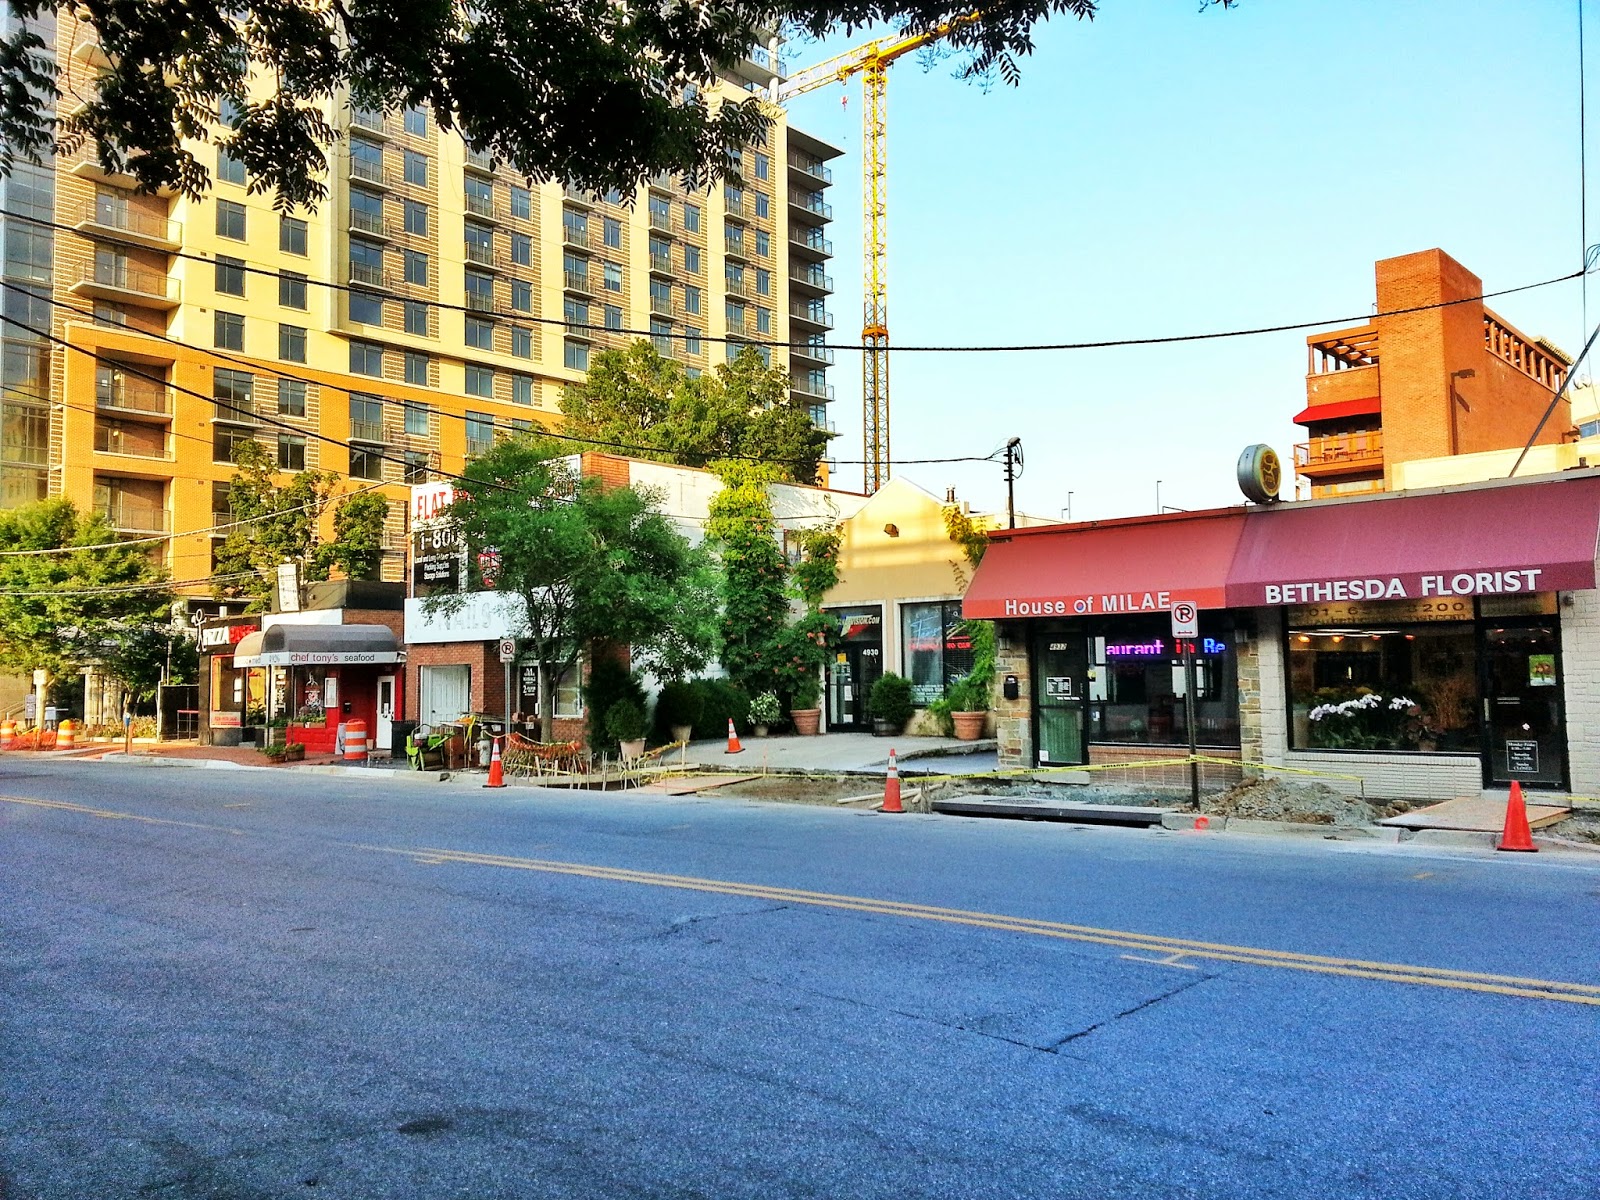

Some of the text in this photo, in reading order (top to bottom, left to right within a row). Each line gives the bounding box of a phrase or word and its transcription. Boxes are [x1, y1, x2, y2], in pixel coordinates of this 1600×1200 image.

[1265, 569, 1542, 604] BETHESDA FLORIST
[1005, 599, 1066, 615] House
[1102, 591, 1171, 612] MILAE
[1106, 639, 1164, 655] aurant
[1203, 638, 1226, 654] Re
[290, 653, 309, 662] chef
[313, 654, 339, 664] tony's
[344, 654, 375, 662] seafood
